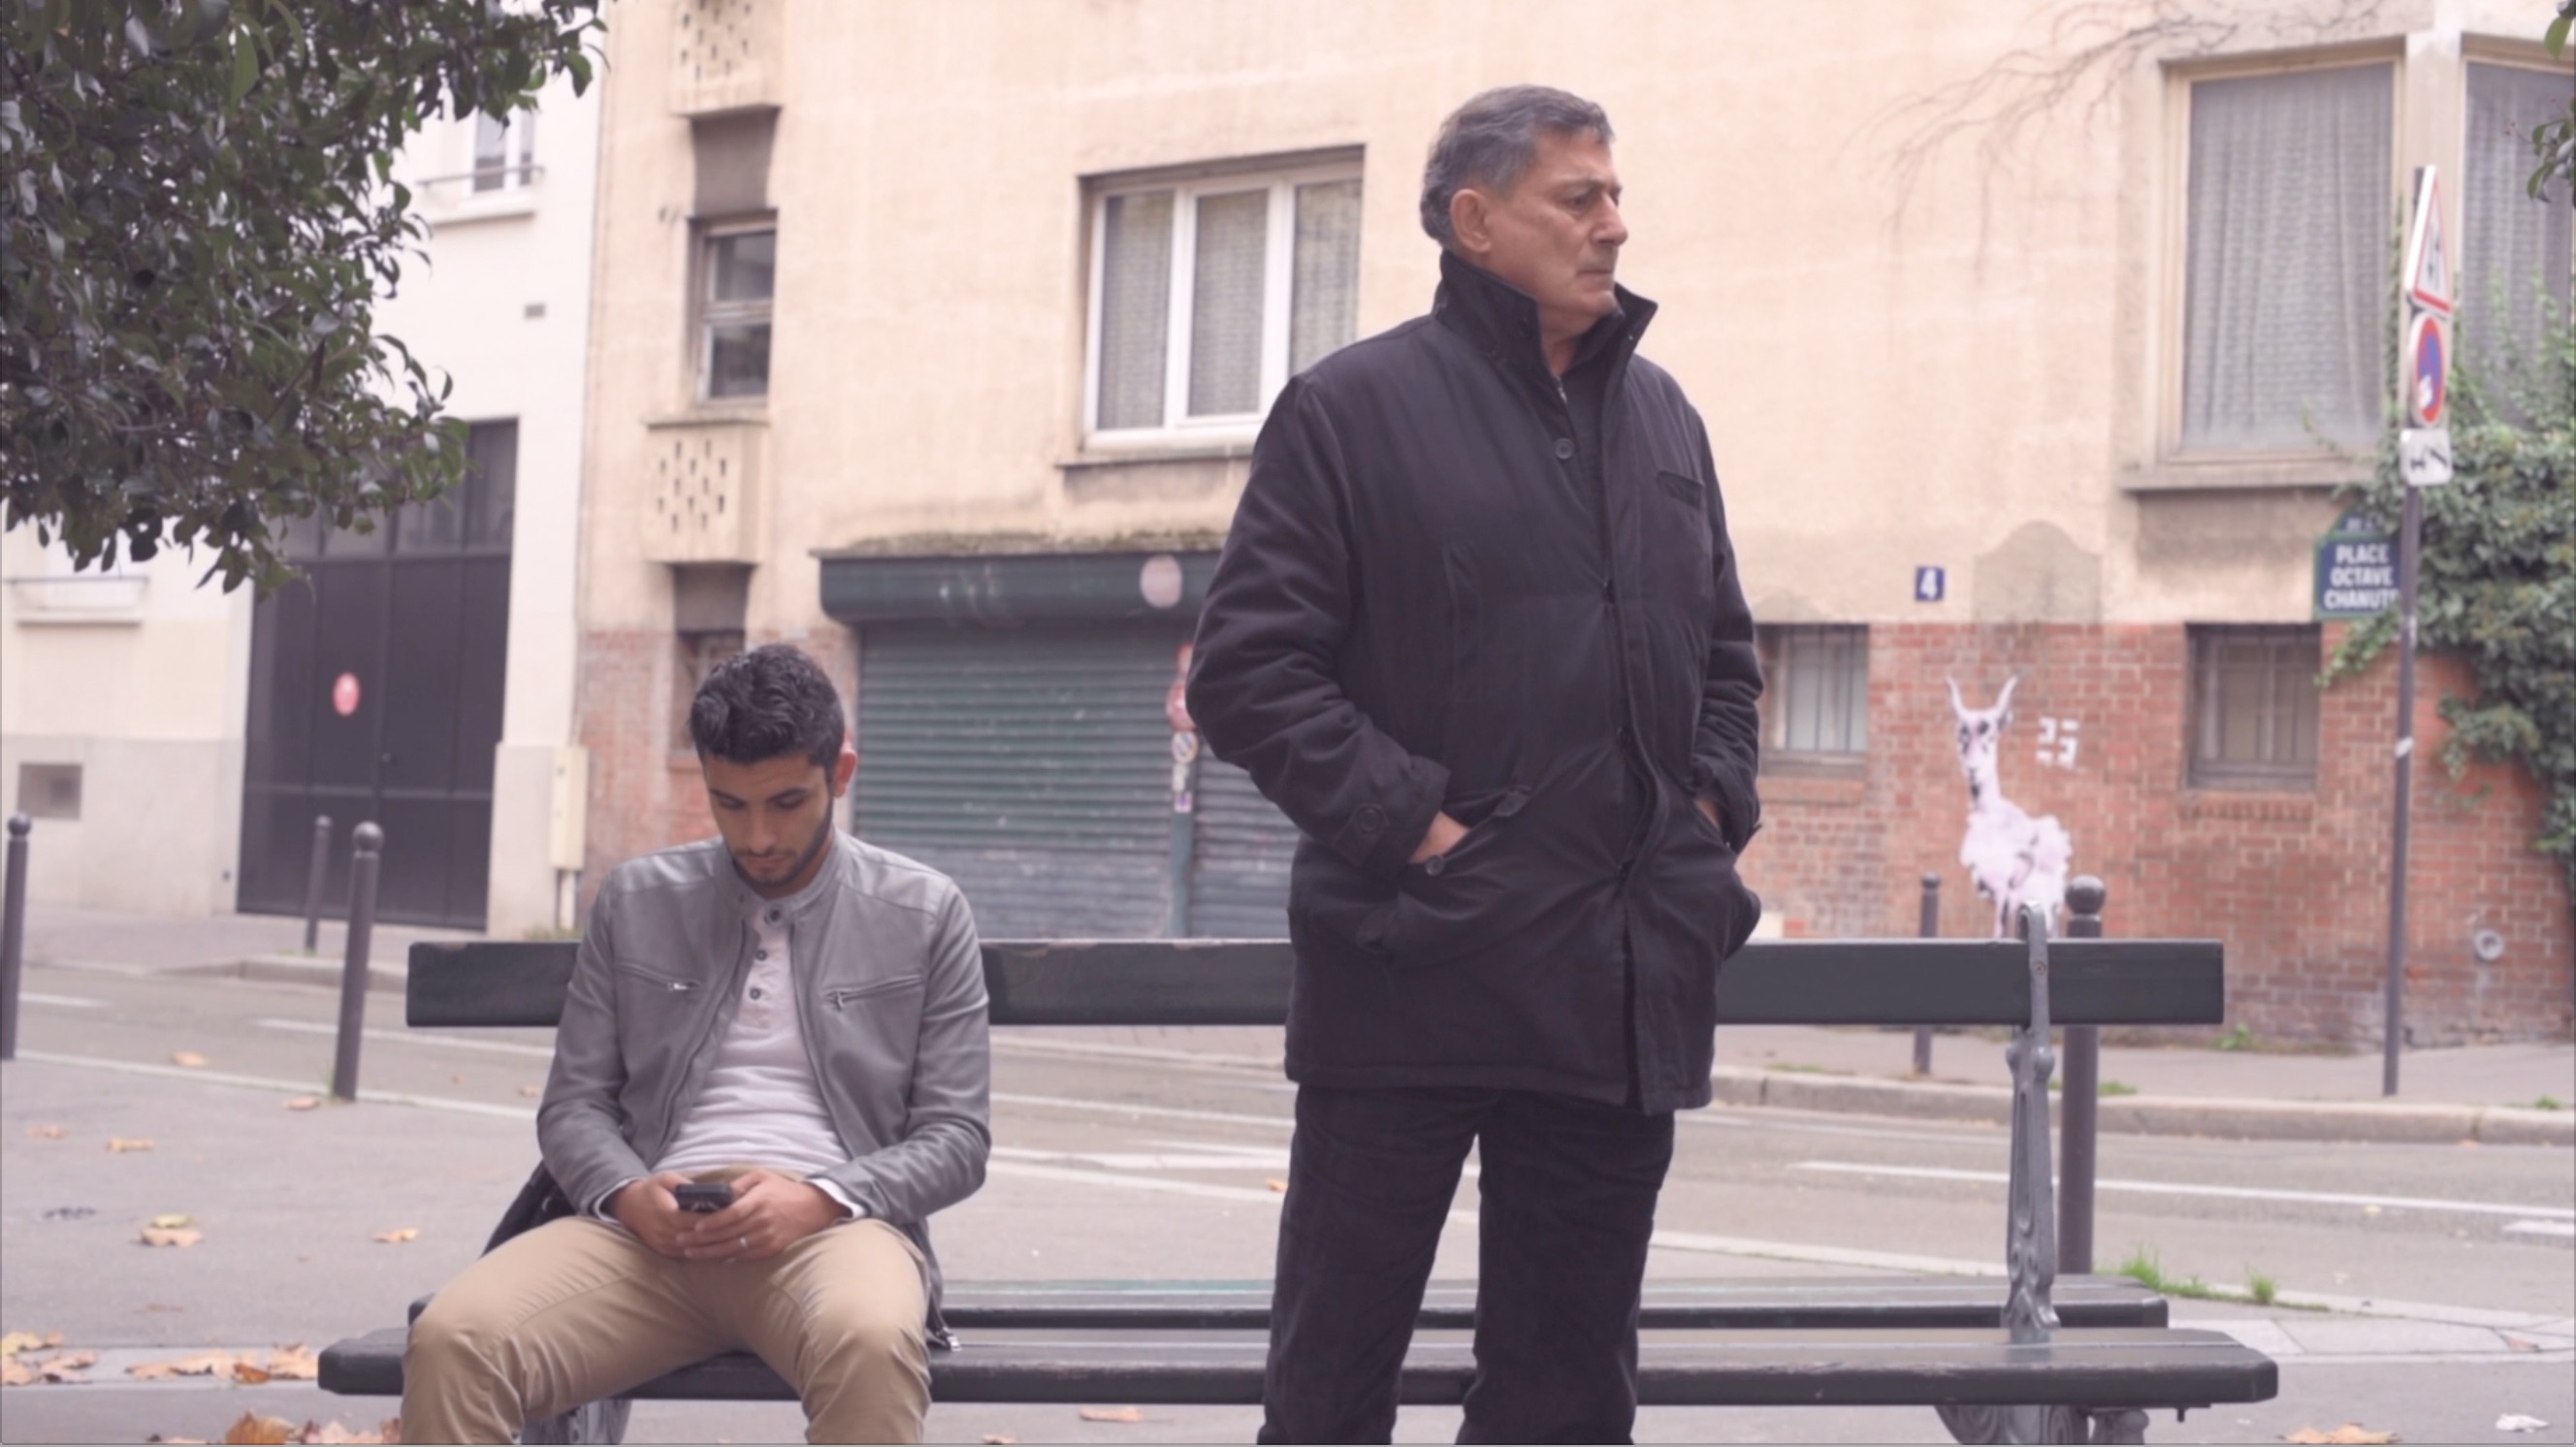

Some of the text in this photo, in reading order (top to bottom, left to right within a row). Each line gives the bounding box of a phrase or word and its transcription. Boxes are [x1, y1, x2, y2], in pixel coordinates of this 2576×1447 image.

[2335, 544, 2390, 564] PLACE
[1919, 567, 1938, 599] 4
[2330, 566, 2394, 587] OCTAVE
